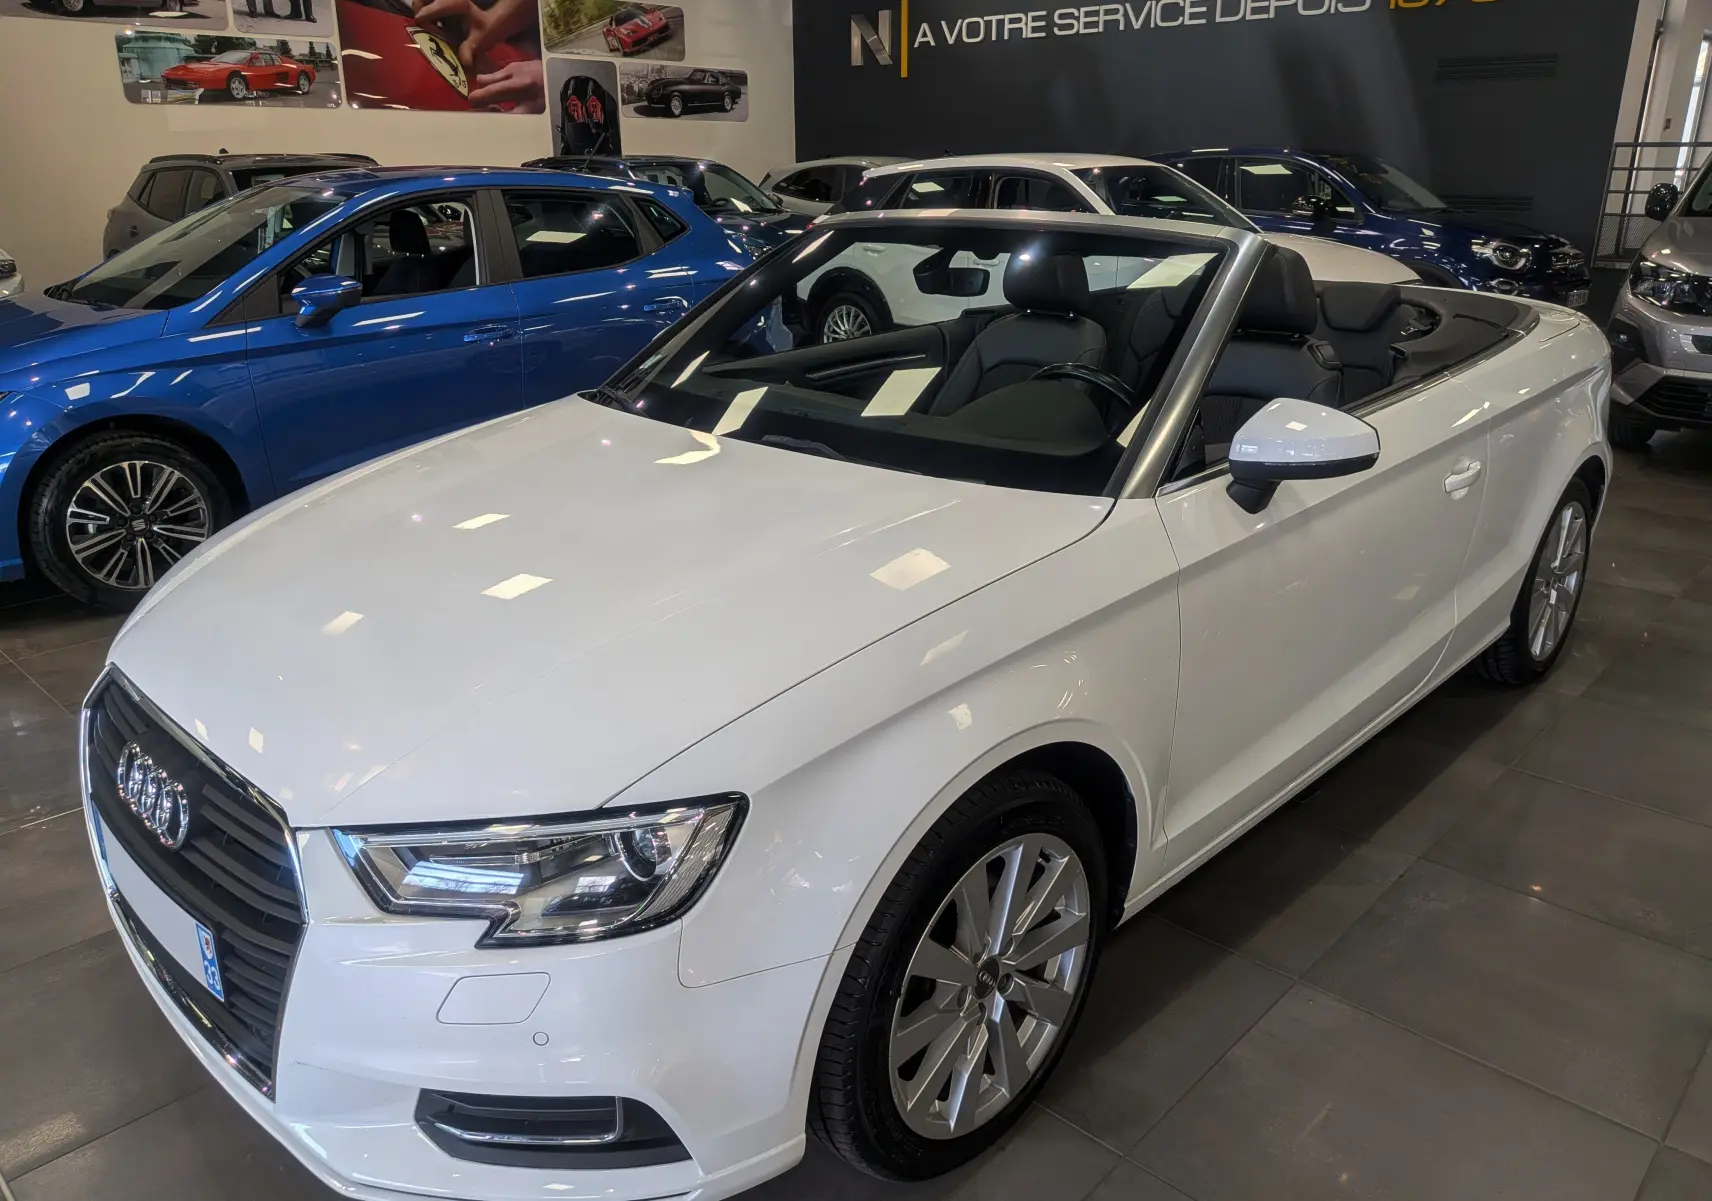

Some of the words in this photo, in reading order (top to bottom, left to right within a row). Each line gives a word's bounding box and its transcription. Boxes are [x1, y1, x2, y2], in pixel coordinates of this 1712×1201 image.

[850, 9, 893, 66] N
[913, 22, 936, 48] A
[940, 10, 1047, 46] VOTRE
[1053, 0, 1208, 36] SERVICE
[203, 960, 221, 990] 33
